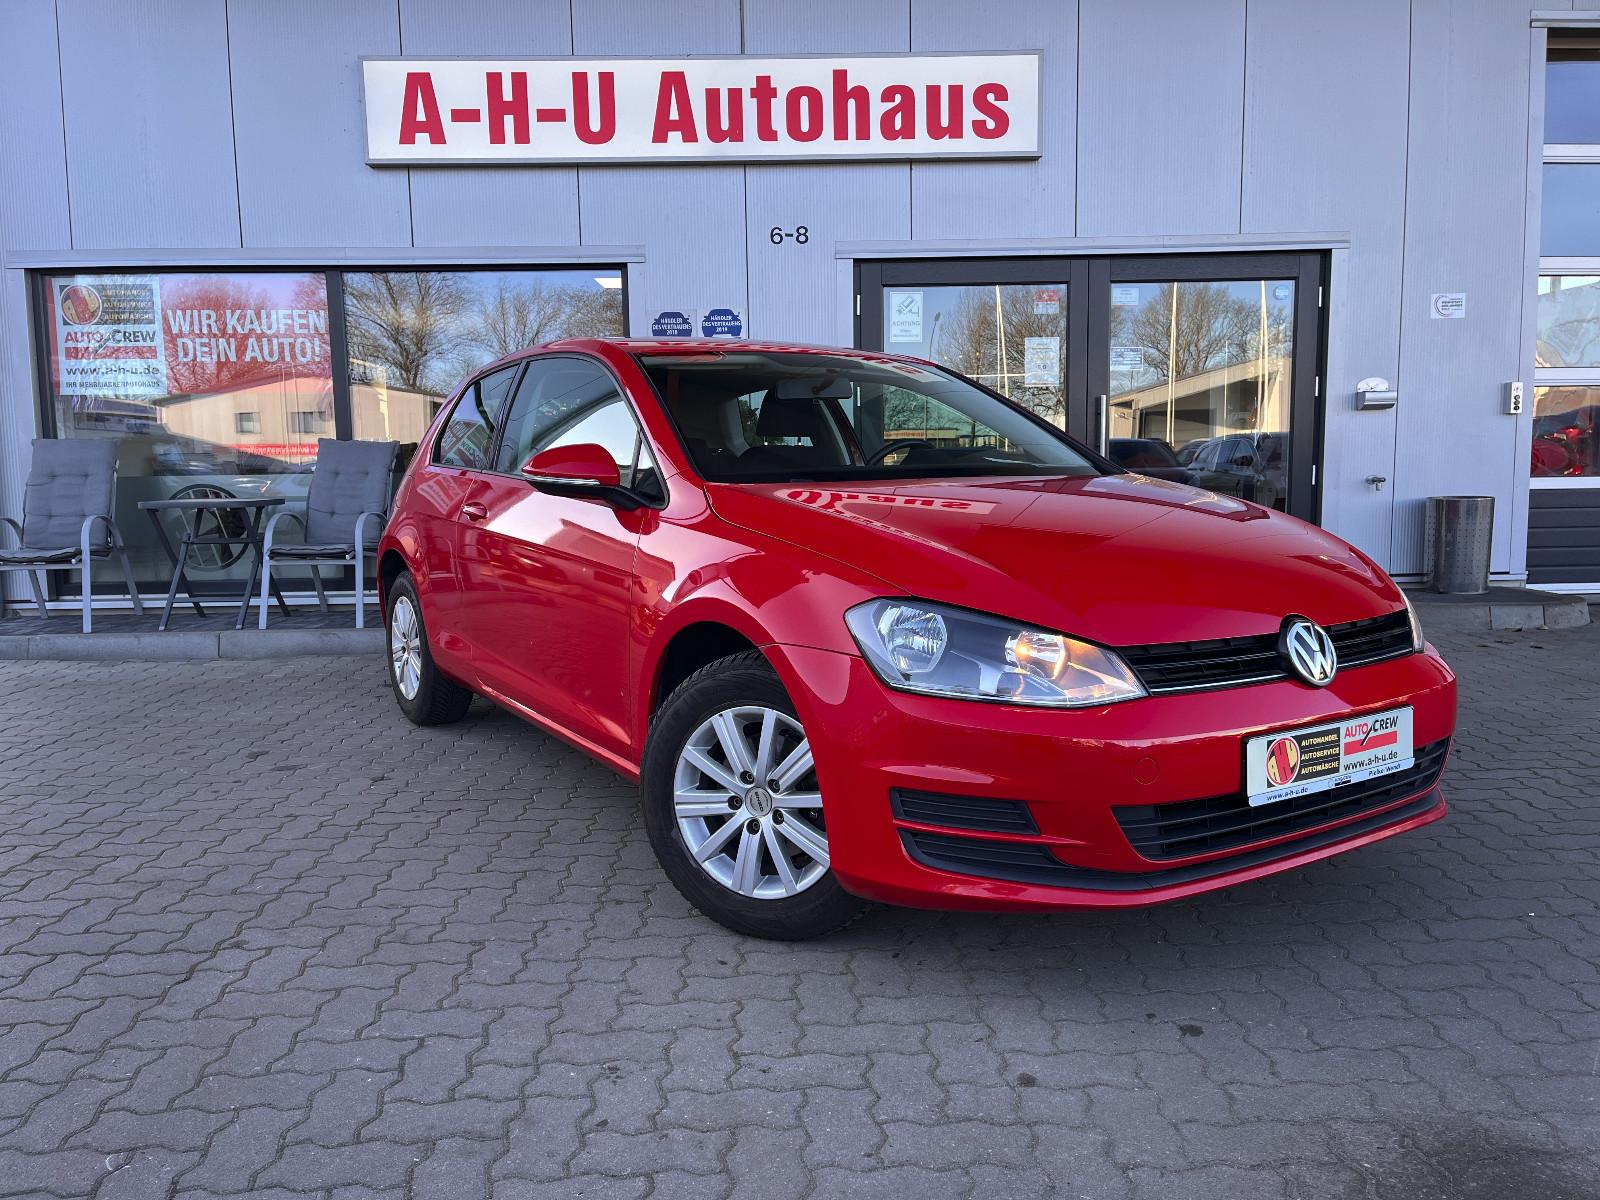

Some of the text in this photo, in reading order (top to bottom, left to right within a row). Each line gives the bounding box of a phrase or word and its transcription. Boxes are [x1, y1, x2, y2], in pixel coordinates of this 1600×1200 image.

[399, 68, 1010, 145] A-H-U Autohaus
[770, 226, 809, 244] 6-8
[167, 309, 326, 335] WIR KAUFEN
[111, 329, 156, 343] CREW
[177, 337, 321, 362] DEIN AUTO!
[1344, 716, 1399, 739] AUTO CREW
[1301, 734, 1338, 747] AUTOHANDEL
[1301, 748, 1339, 760] AUTOSERVICE
[1343, 750, 1398, 771] www.a-h-u.de
